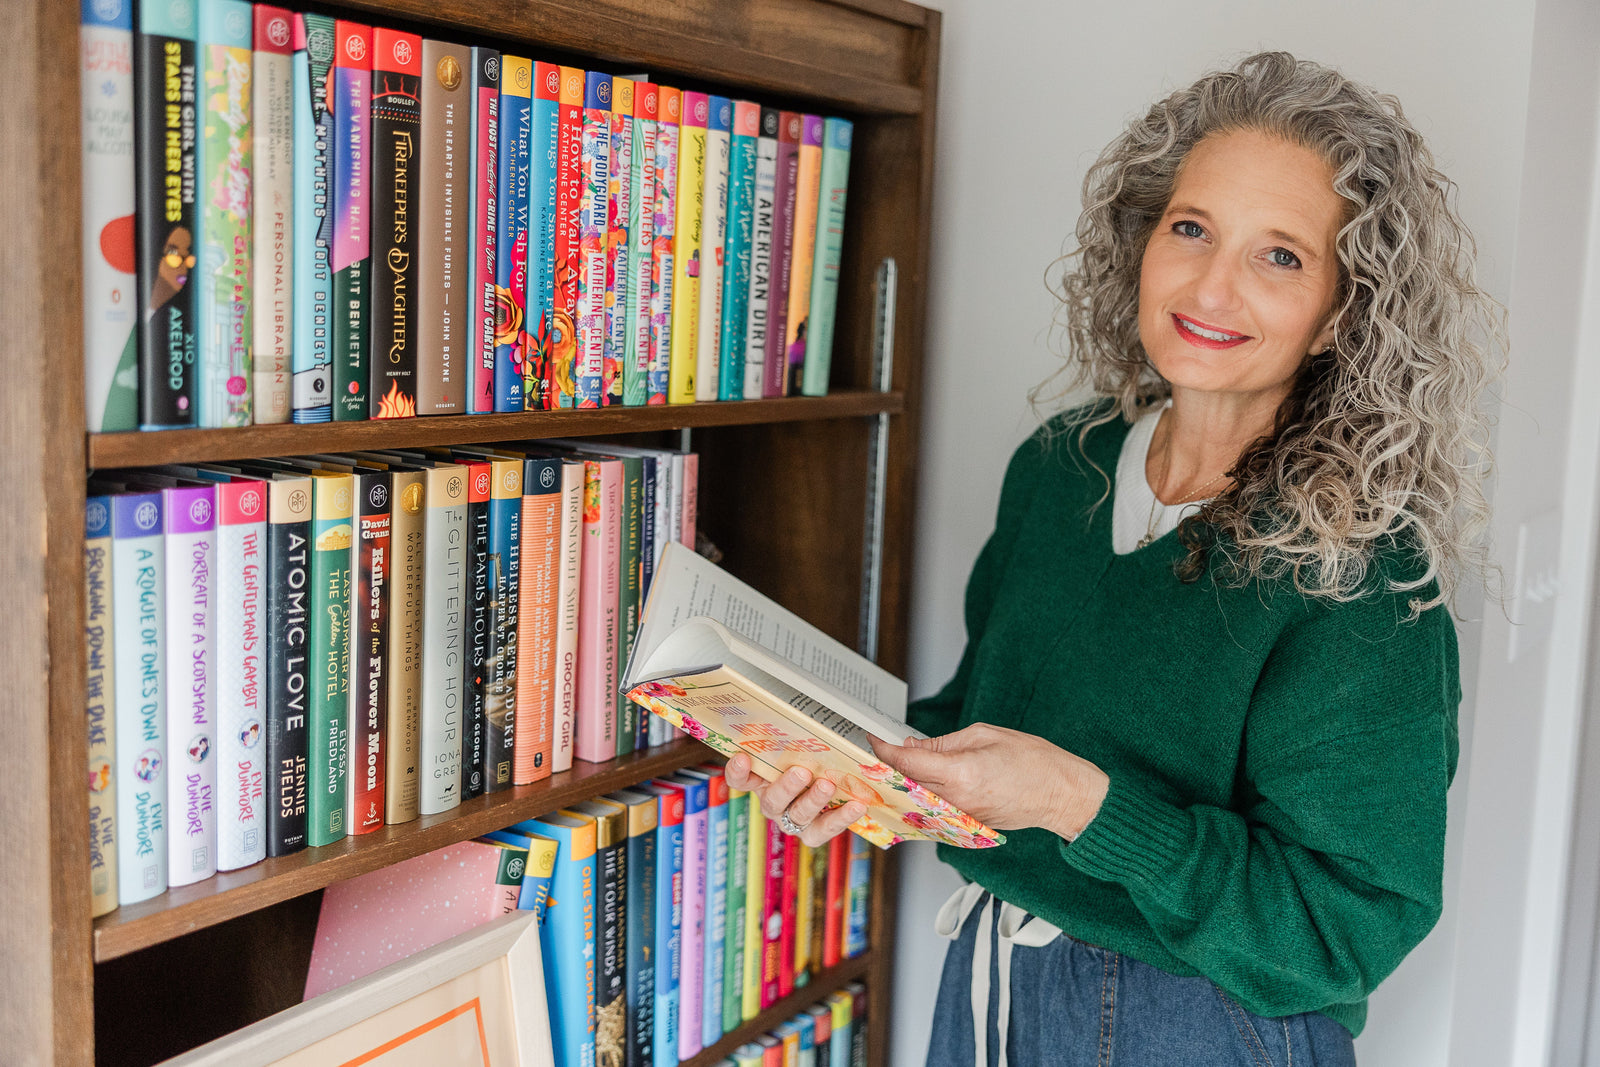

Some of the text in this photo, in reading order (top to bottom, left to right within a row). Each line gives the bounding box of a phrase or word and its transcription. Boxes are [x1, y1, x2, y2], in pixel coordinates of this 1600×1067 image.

[165, 41, 182, 222] STARS IN HER EYES
[182, 65, 195, 204] THE GIRL WITH
[314, 75, 327, 218] THE MOTHERS
[387, 96, 416, 107] BOULLEY
[488, 119, 497, 149] MOST
[489, 97, 497, 117] THE
[350, 80, 361, 243] THE VANISHING HALF
[507, 139, 517, 239] KATHERINE CENTER
[515, 106, 531, 292] What You Wish For
[559, 123, 569, 237] KATHERINE CENTER
[593, 123, 609, 227] THE BODYGUARD
[620, 117, 633, 225] HELLO STRANGER
[641, 130, 655, 247] THE LOVE HATERS
[442, 103, 454, 383] THE HEART'S INVISIBLE FURIES JOHN BOYNE
[486, 197, 496, 233] CRIME
[539, 206, 547, 263] KATHERINE
[546, 177, 558, 275] You Save in
[564, 124, 583, 321] How to Walk Away
[754, 198, 772, 300] AMERICAN
[232, 235, 247, 354] CARA BASTONE
[274, 212, 284, 384] PERSONAL LIBRARIAN
[314, 239, 327, 372] BRIT BENNETT
[349, 260, 361, 369] BRIT BENNETT
[388, 247, 410, 364] DAUGHTER
[482, 281, 496, 370] ALLY CARTER
[591, 256, 605, 321] KATHERINE
[614, 247, 628, 359] KATHERINE CENTER
[638, 260, 651, 369] KATHERINE CENTER
[660, 257, 673, 369] KATHERINE CENTER
[752, 309, 768, 351] DIRT
[169, 306, 184, 391] AXELROD
[184, 333, 195, 365] XIO
[588, 327, 603, 374] CENTER
[361, 517, 391, 530] David
[361, 529, 390, 540] Grann
[445, 510, 463, 523] The
[242, 530, 259, 710] THE GENTLEMAN'S GAMBIT
[340, 569, 351, 675] LAST SUMMER
[404, 532, 413, 617] WONDERFUL
[473, 513, 488, 668] THE PARIS HOURS
[565, 587, 577, 632] SMITH
[627, 604, 635, 632] TAKE
[135, 548, 159, 742] A ROGUE OF ONE'S OWN
[191, 539, 209, 725] PORTRAIT OF A SCOTSMAN
[286, 533, 307, 732] ATOMIC LOVE
[326, 569, 343, 702] THE Golden HOTEL
[367, 547, 384, 792] Killers of the Flower Moon
[444, 528, 460, 744] GLITTERING HOUR
[495, 575, 507, 693] HARPER GEORGE
[503, 512, 520, 749] THE HEIRESS GETS DUKE
[604, 618, 614, 742] TIMES MAKE SURE
[473, 723, 481, 765] GEORGE
[560, 651, 573, 753] GROCERY GIRL
[200, 784, 213, 815] EVIE
[237, 760, 255, 824] DUNMORE
[250, 770, 263, 801] EVIE
[281, 758, 294, 819] FIELDS
[295, 755, 306, 817] JENNIE
[328, 718, 339, 795] FRIEDLAND
[338, 729, 347, 779] ELYSSA
[433, 763, 461, 779] GREY
[435, 748, 461, 765] IONA
[135, 791, 154, 859] DUNMORE
[150, 801, 163, 834] EVIE
[186, 773, 204, 837] DUNMORE
[581, 865, 595, 942] ONE-STAR
[604, 850, 618, 977] THE FOUR WINDS
[584, 959, 595, 1035] ROMANCE
